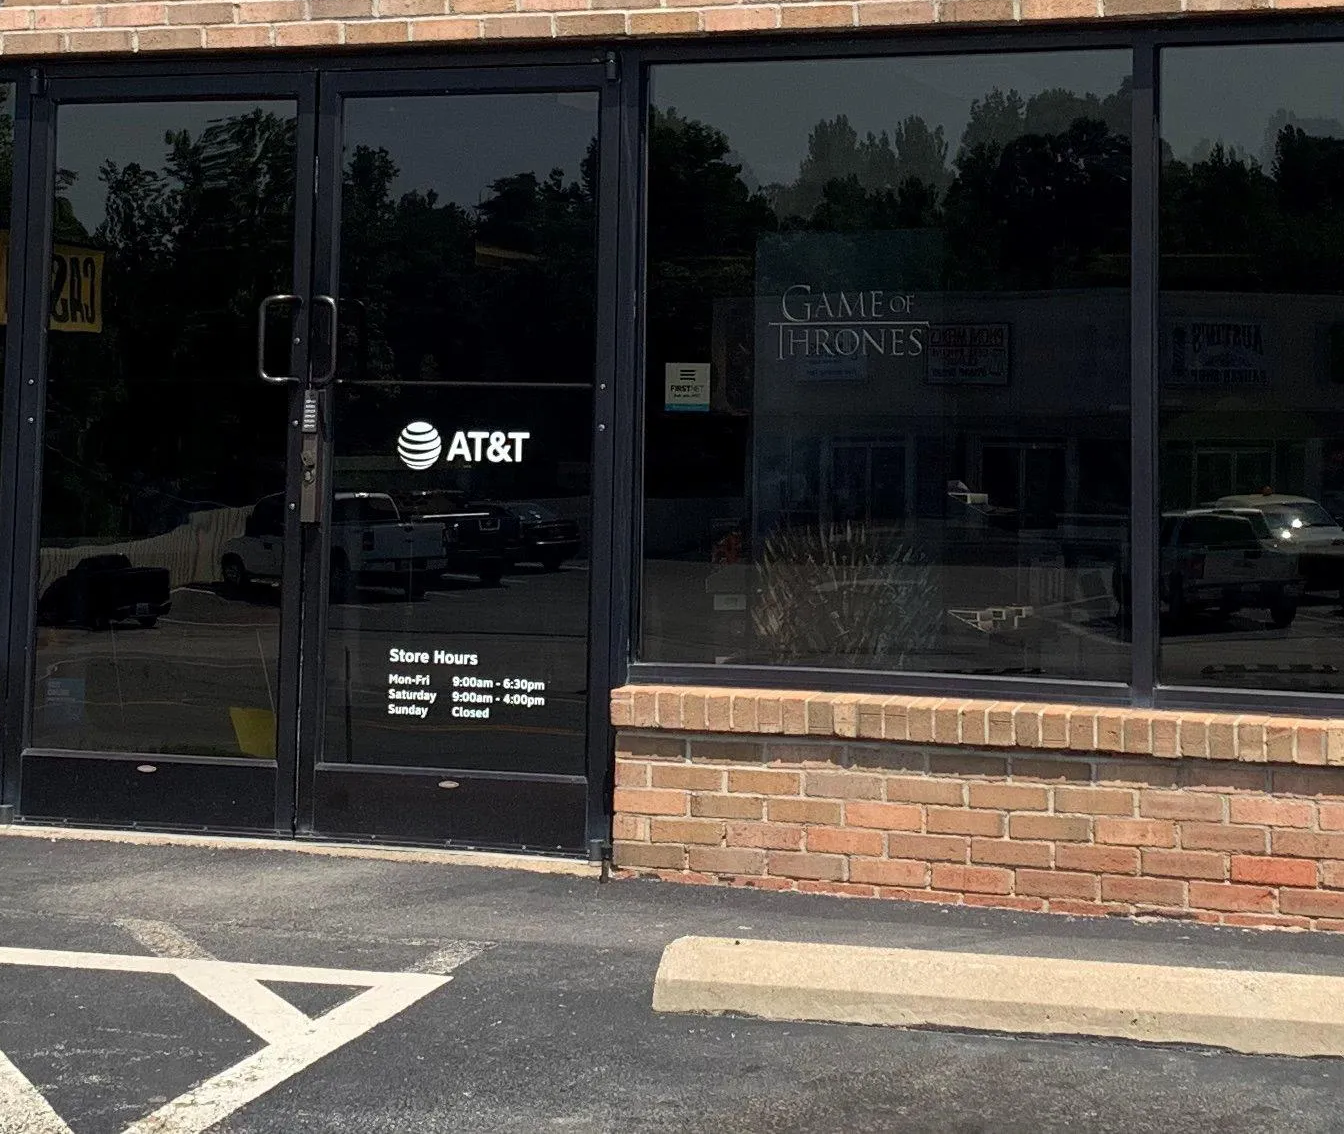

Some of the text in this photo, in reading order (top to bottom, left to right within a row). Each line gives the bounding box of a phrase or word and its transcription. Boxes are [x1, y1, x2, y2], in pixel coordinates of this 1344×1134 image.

[782, 284, 915, 322] GAME OF
[768, 321, 930, 361] THRONES
[446, 431, 531, 463] AT&T
[389, 648, 479, 666] Store Hours
[388, 674, 431, 686] Mon-Fri
[452, 676, 494, 689] 9:00am
[503, 678, 545, 693] 6:30pm
[388, 689, 437, 704] Saturday
[452, 691, 493, 704] 9:00am
[503, 693, 545, 708] 4:00pm
[388, 704, 490, 719] Sunday Closed
